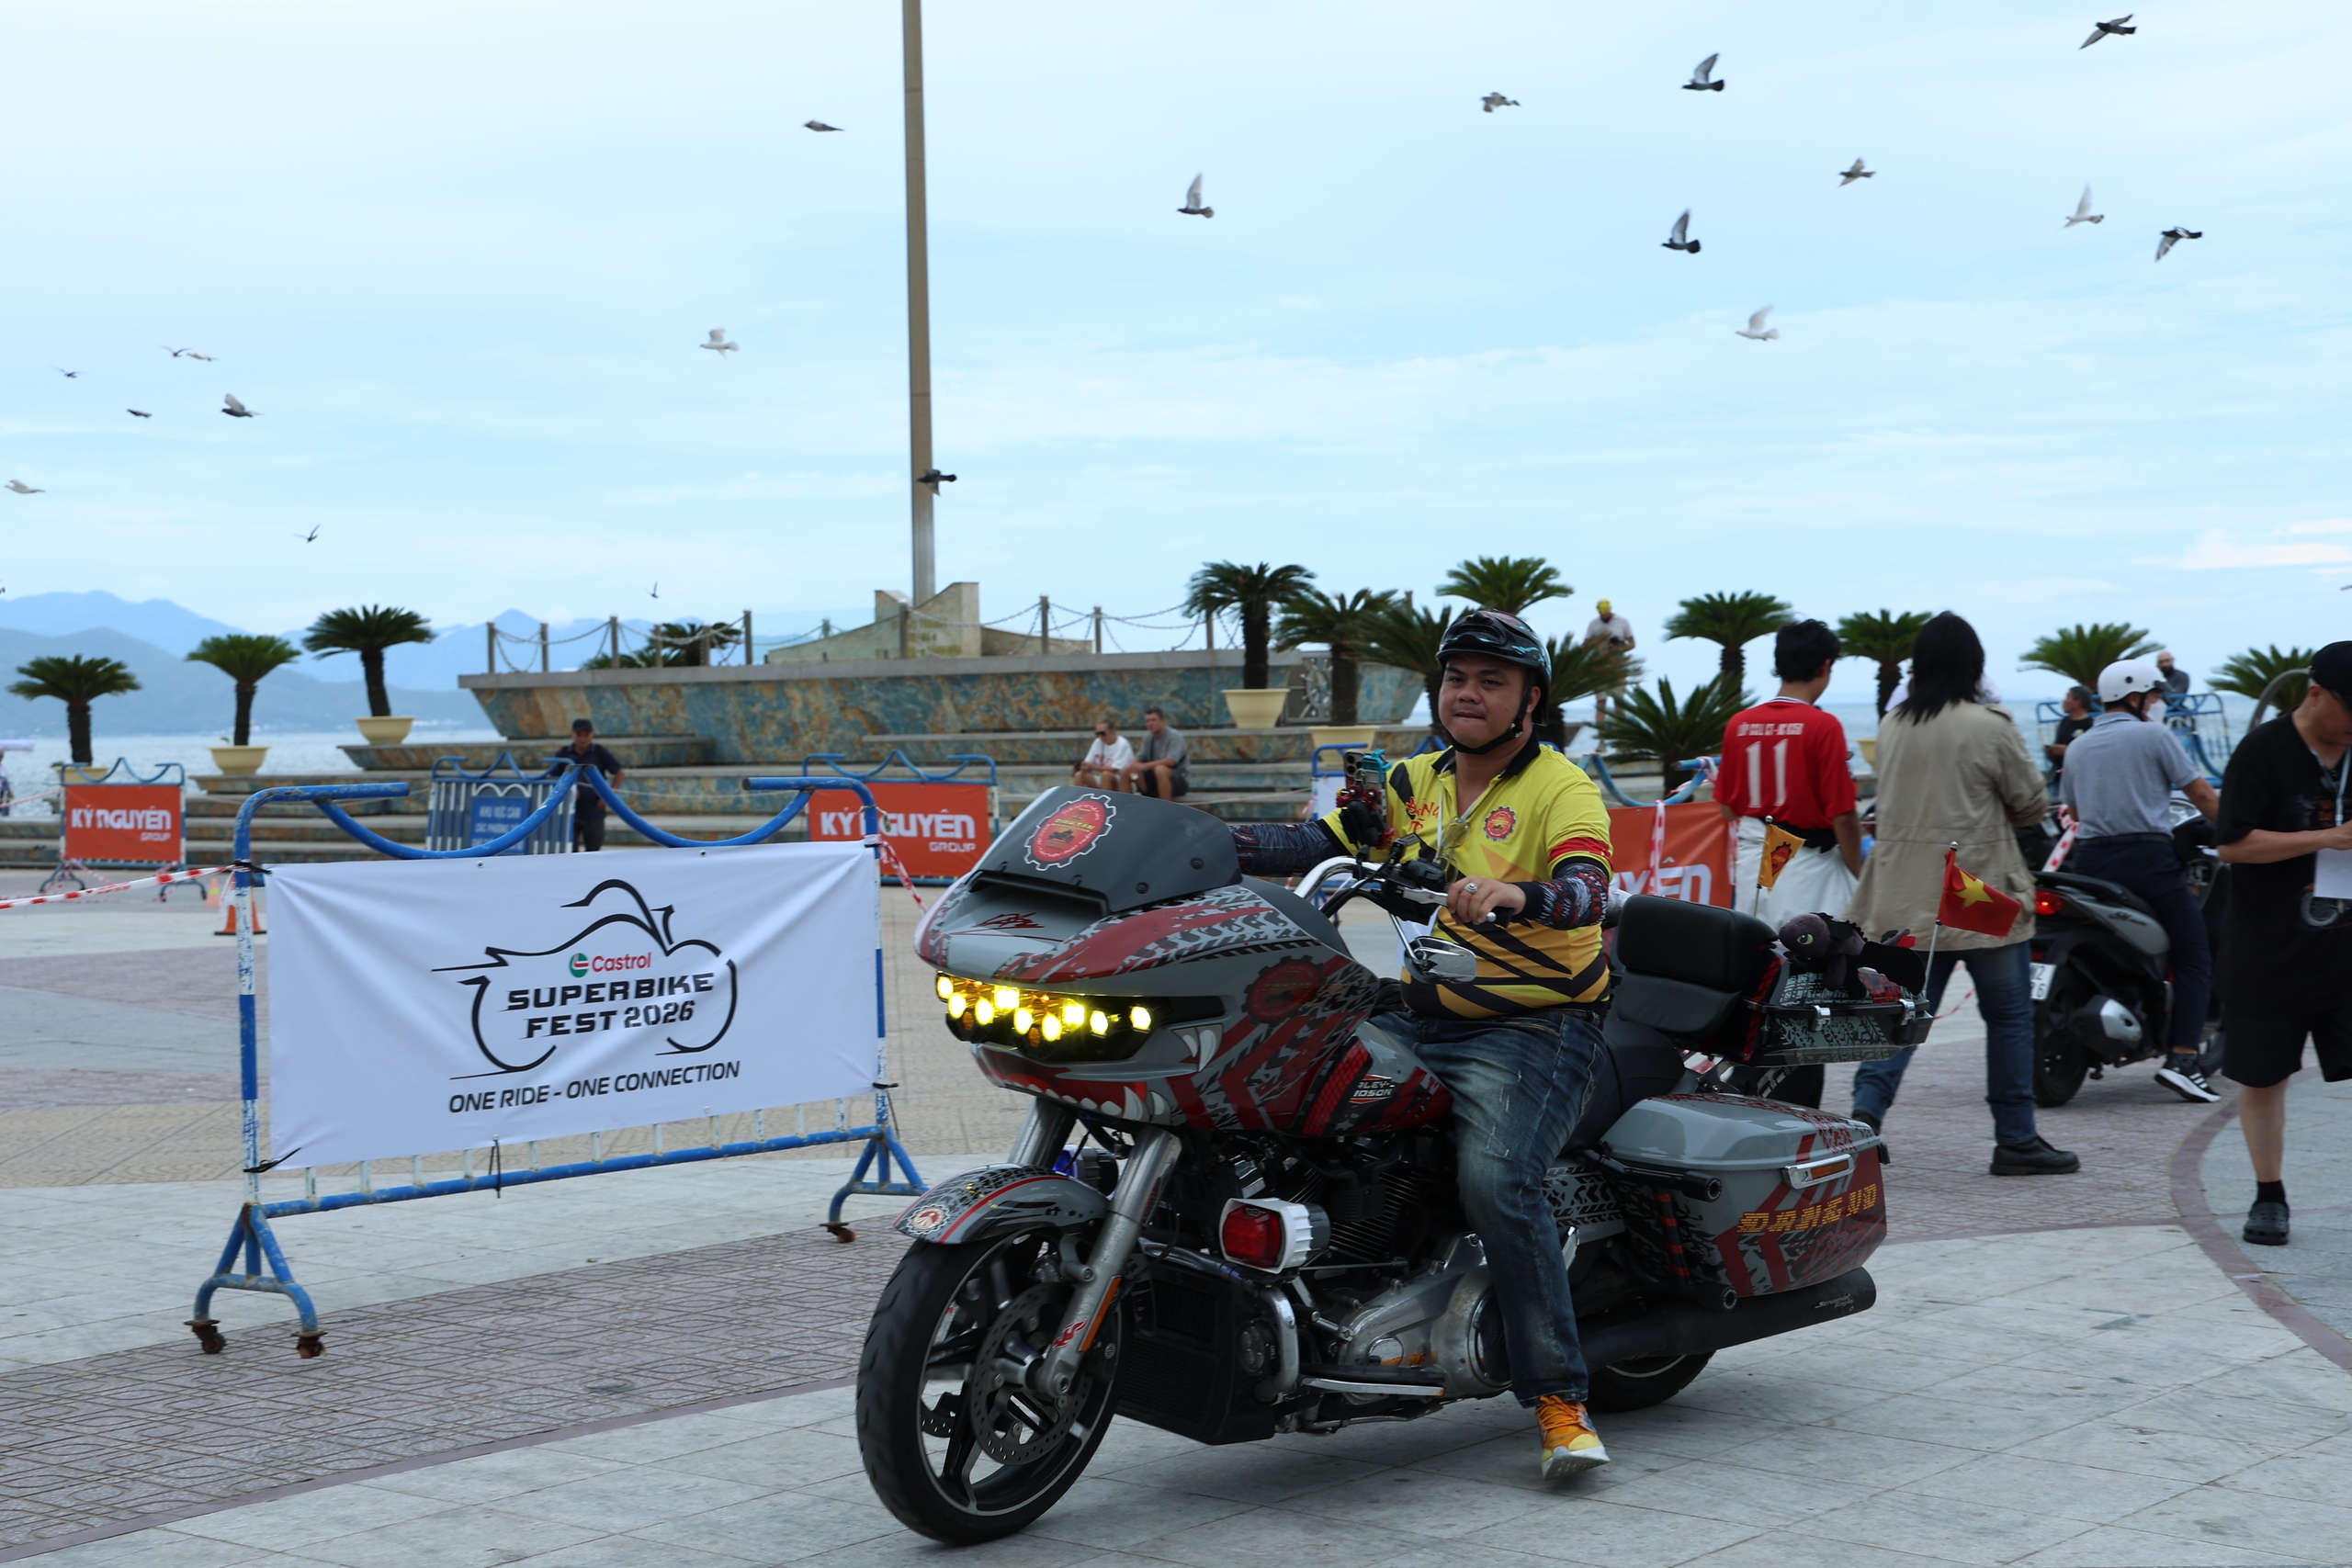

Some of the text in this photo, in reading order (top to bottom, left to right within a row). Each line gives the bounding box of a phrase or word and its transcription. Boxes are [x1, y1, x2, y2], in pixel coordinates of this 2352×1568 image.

[1745, 739, 1789, 808] 11
[860, 808, 976, 840] GUYÊN
[929, 841, 977, 853] GROUP
[592, 952, 651, 974] Castrol
[499, 972, 714, 1012] SUPERBIKE
[519, 999, 695, 1040] FEST 2026
[448, 1090, 496, 1113] ONE
[499, 1084, 550, 1109] RIDE
[566, 1077, 611, 1100] ONE
[614, 1060, 741, 1092] CONNECTION
